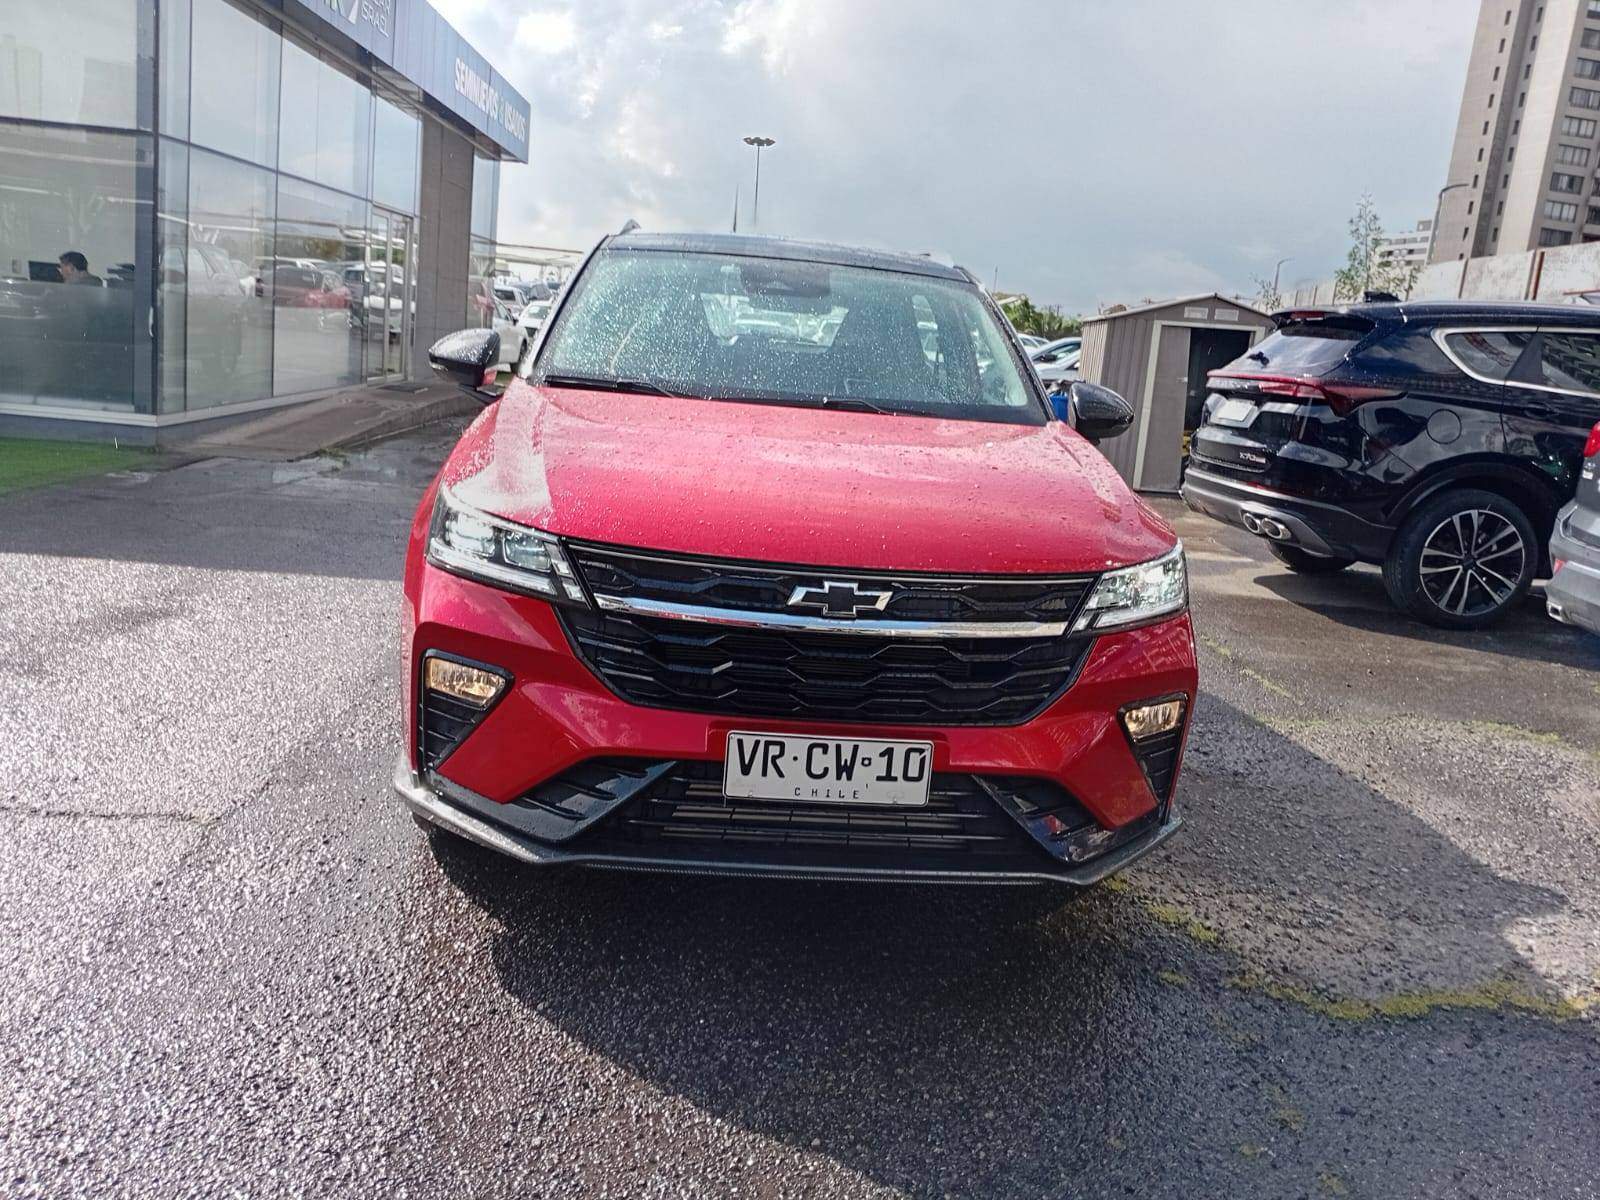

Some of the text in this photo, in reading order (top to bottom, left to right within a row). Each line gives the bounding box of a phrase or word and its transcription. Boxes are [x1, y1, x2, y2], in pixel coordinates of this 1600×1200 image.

[455, 57, 499, 120] SEMINUEVOS
[504, 101, 525, 142] USADOS
[794, 787, 860, 799] CHILE
